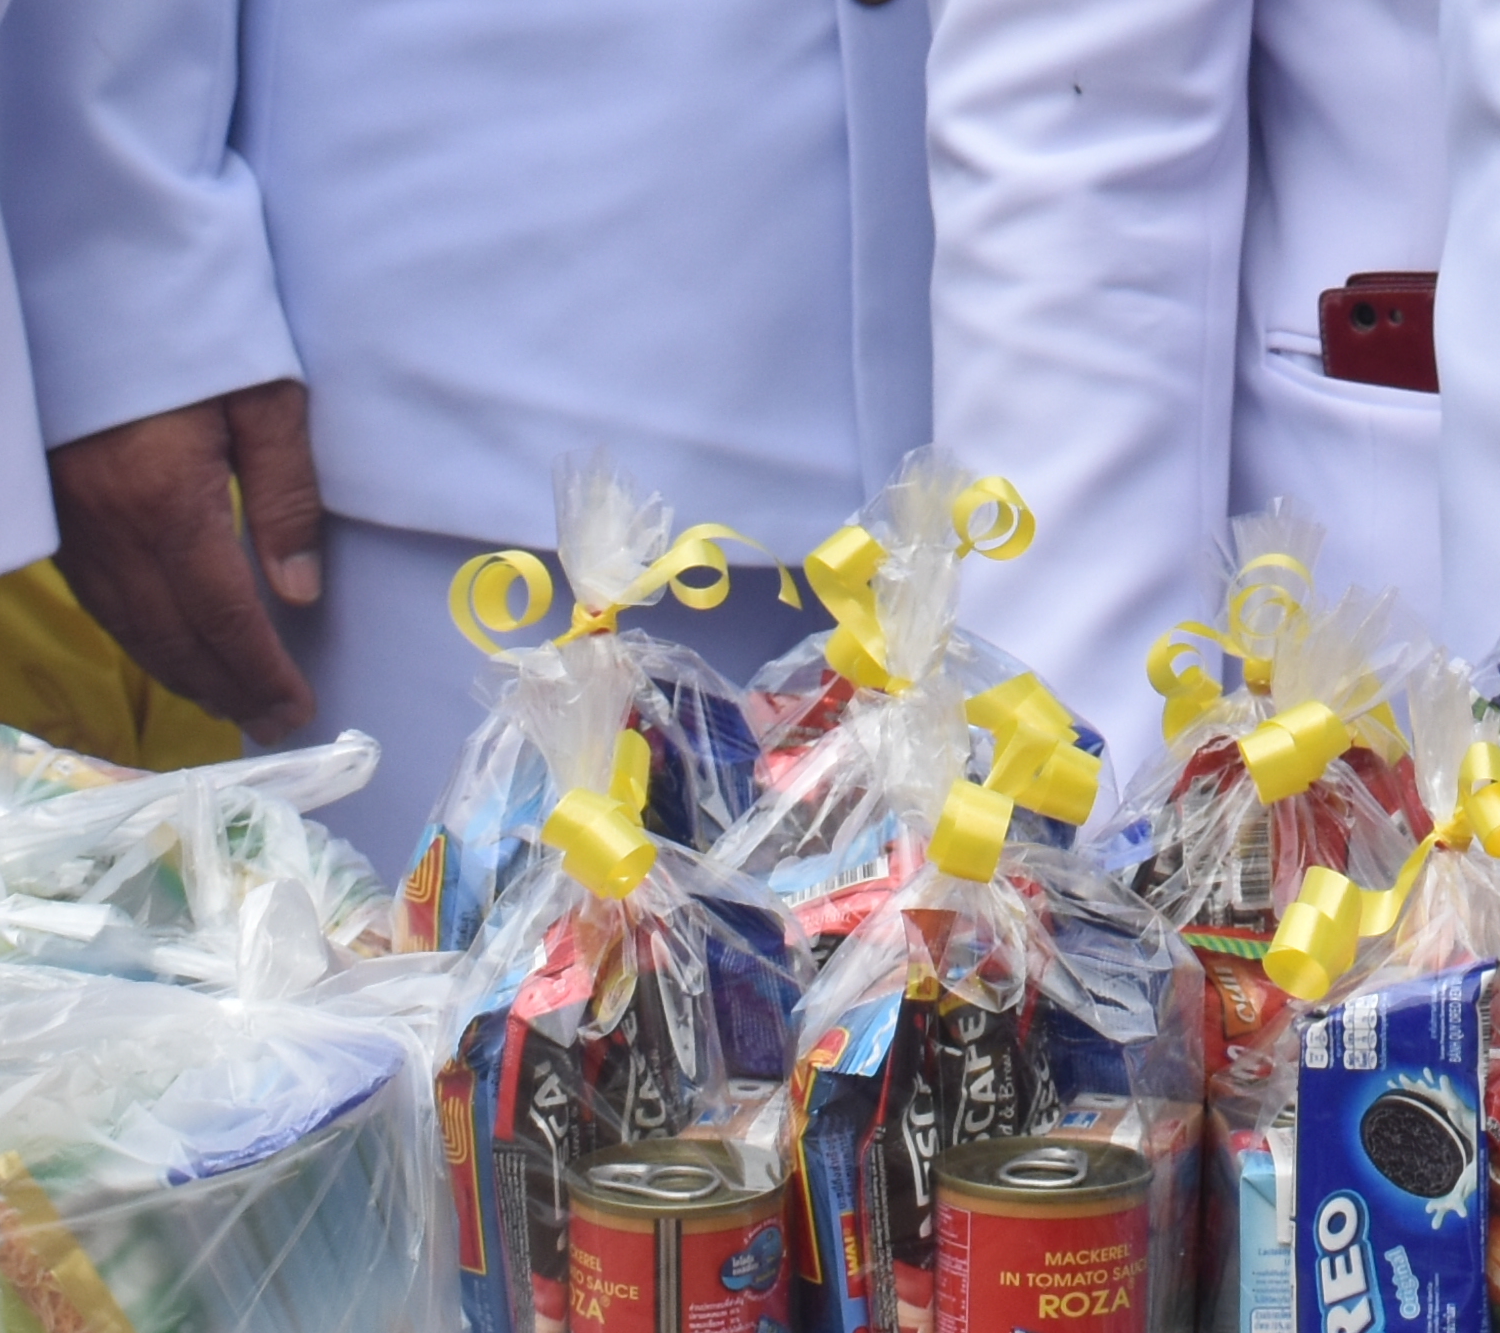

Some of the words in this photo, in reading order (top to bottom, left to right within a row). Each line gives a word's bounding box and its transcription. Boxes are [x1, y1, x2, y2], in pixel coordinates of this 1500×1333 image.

[1045, 1244, 1130, 1267] MACKEREL
[1317, 1195, 1376, 1333] REO
[586, 1275, 639, 1300] SAUCE
[1000, 1271, 1020, 1287] IN
[1027, 1269, 1107, 1288] TOMATO
[1386, 1246, 1419, 1319] Original
[1038, 1290, 1131, 1319] ROZA
